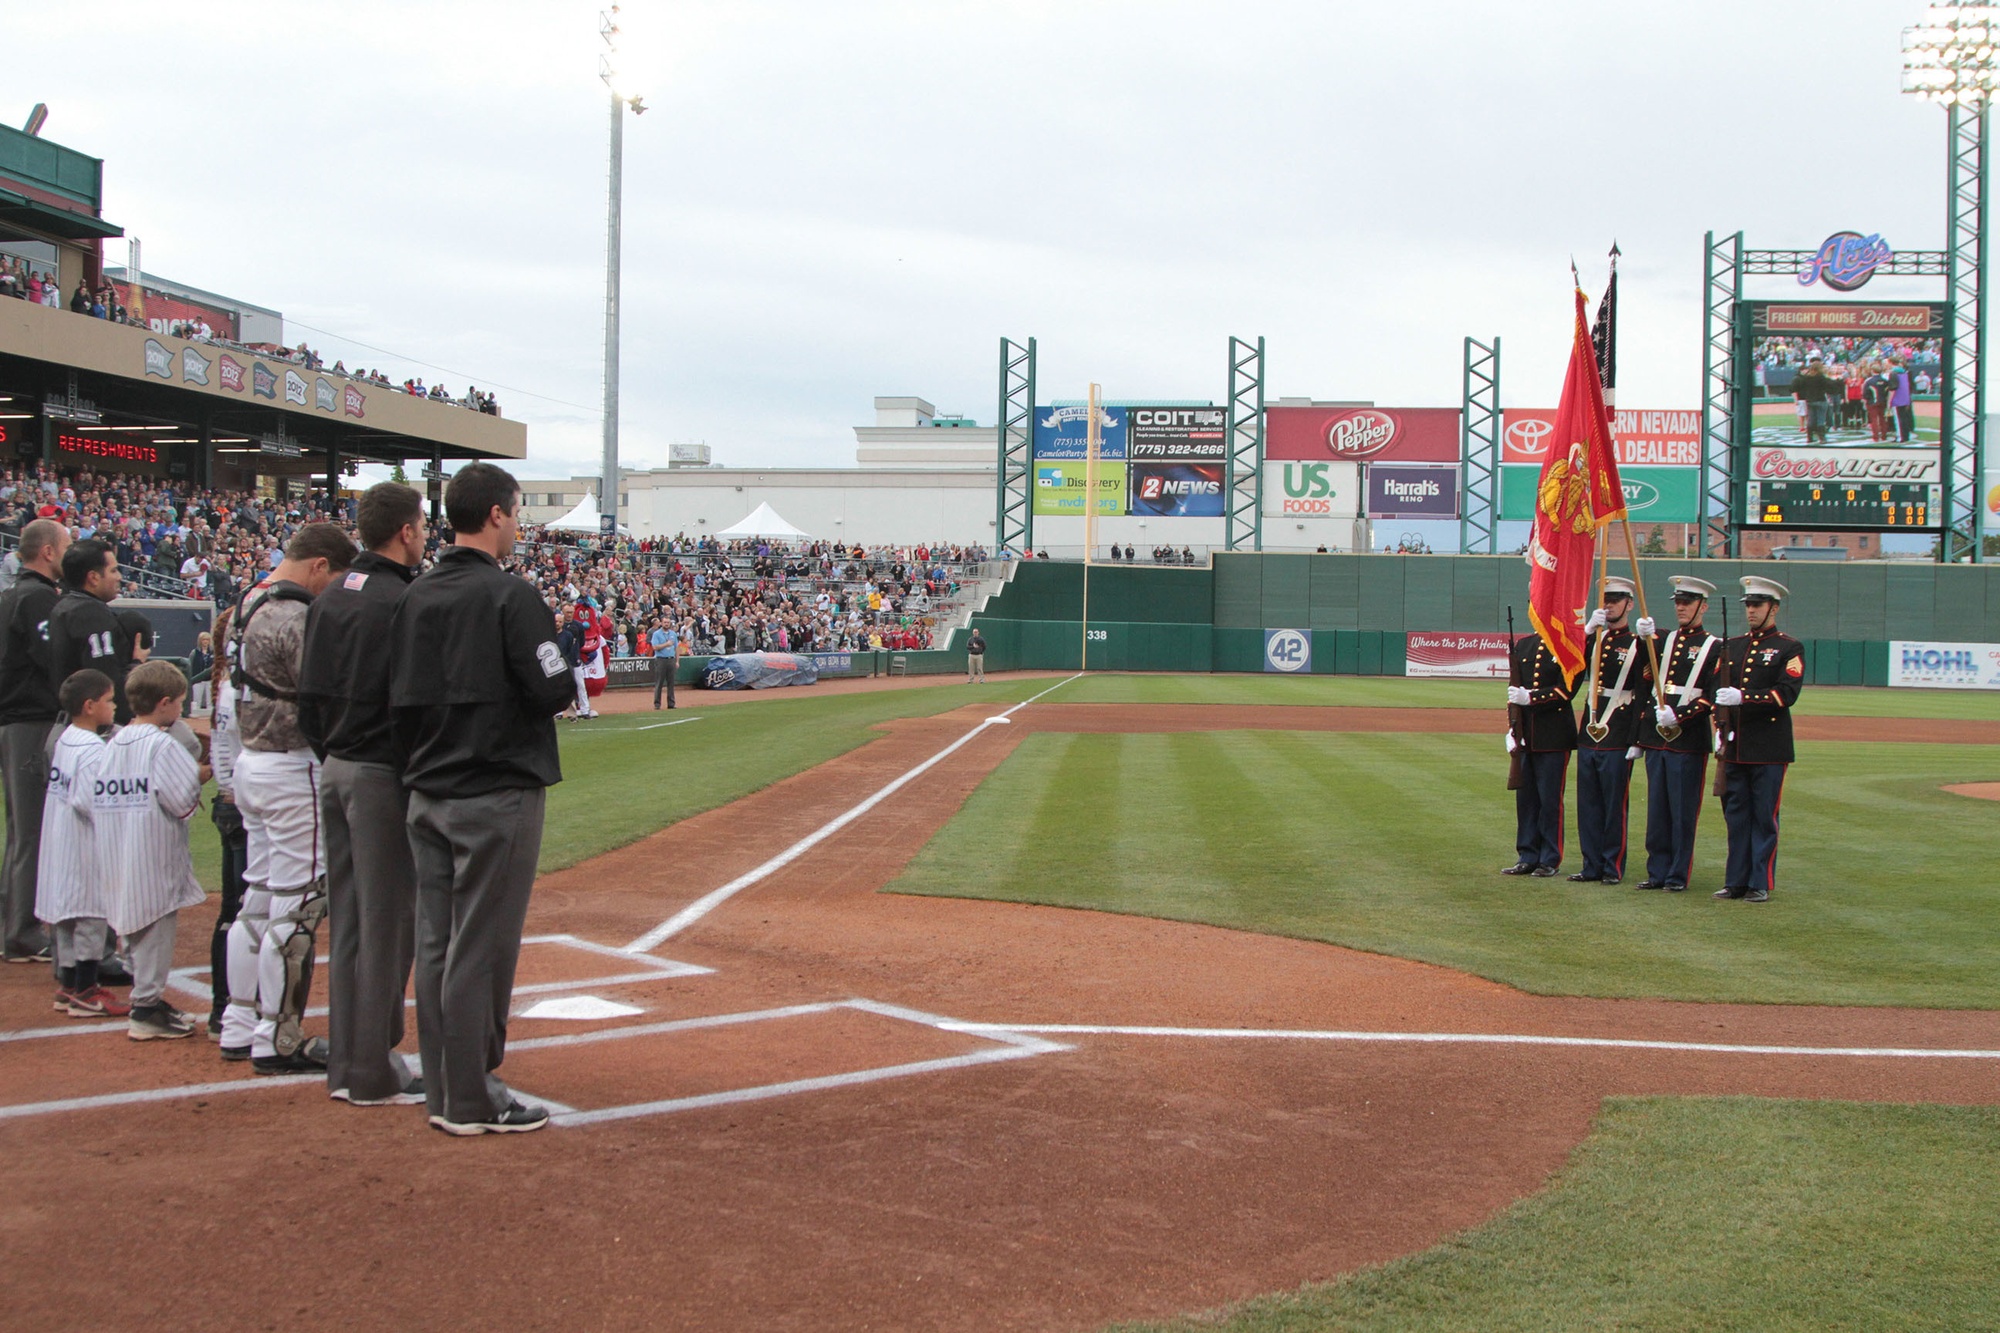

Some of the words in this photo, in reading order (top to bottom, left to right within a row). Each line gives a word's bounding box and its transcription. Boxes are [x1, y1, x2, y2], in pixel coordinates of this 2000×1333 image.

[1798, 236, 1893, 286] Aces
[1771, 312, 1817, 324] FREIGHT
[1820, 312, 1856, 324] HOUSE
[1859, 309, 1923, 326] District
[186, 359, 203, 376] 2012
[222, 366, 239, 383] 2012
[288, 380, 303, 397] 2012
[346, 394, 360, 409] 2014
[1136, 410, 1195, 426] COIT
[1352, 415, 1375, 434] Dr
[1641, 411, 1699, 435] NEVADA
[1053, 438, 1073, 448] (775)
[1330, 420, 1389, 451] Pepper
[58, 435, 157, 463] REFRESHMENTS
[1134, 445, 1166, 455] (775)
[1167, 444, 1224, 455] 322-4266
[1625, 440, 1698, 464] DEALERS
[1753, 449, 1841, 478] Coors
[1838, 459, 1936, 479] LIGHT
[1067, 477, 1120, 490] Discvery
[1143, 478, 1160, 498] 2
[1162, 480, 1220, 495] NEWS
[1283, 463, 1337, 498] US.
[1384, 479, 1440, 496] Harrah's
[1808, 483, 1825, 491] BALL
[1840, 483, 1862, 491] STRIKE
[1058, 496, 1117, 511] nvd.org
[1813, 489, 1821, 501] 0
[1847, 489, 1856, 501] 0
[1881, 489, 1890, 502] 0
[1283, 499, 1331, 513] FOODS
[1087, 630, 1107, 640] 338
[1411, 636, 1440, 649] Where
[1442, 638, 1456, 648] the
[1457, 637, 1478, 650] Best
[88, 631, 115, 658] 11
[1272, 638, 1302, 662] 42
[536, 640, 568, 678] 2
[609, 661, 635, 673] WHITNEY
[636, 660, 650, 671] PEAK
[1902, 650, 1979, 671] HOHL
[706, 669, 736, 688] Aces
